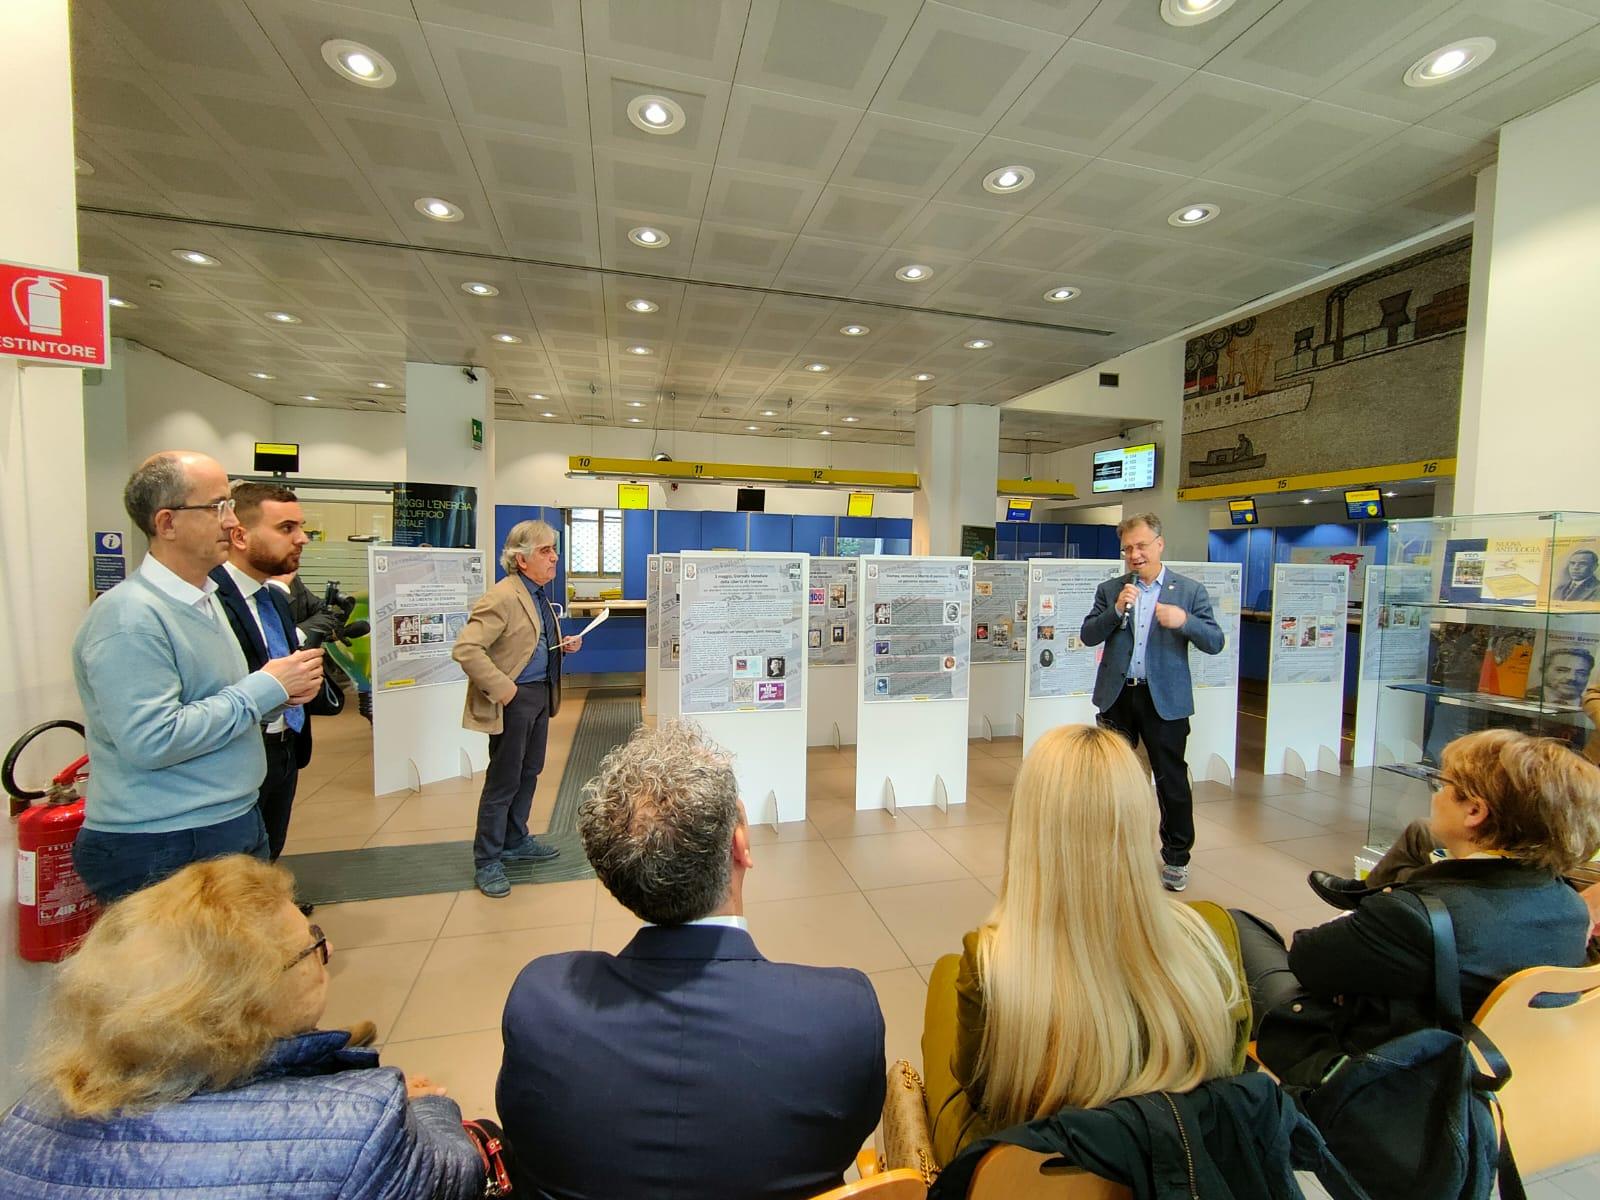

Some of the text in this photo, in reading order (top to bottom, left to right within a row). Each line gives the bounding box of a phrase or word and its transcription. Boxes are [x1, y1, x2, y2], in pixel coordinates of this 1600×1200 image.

[579, 458, 591, 467] 10
[1422, 462, 1438, 473] 16
[694, 464, 704, 474] 11
[813, 470, 823, 480] 12
[1277, 479, 1288, 489] 15
[427, 500, 473, 511] L'ENERGIA
[54, 904, 78, 918] AIR
